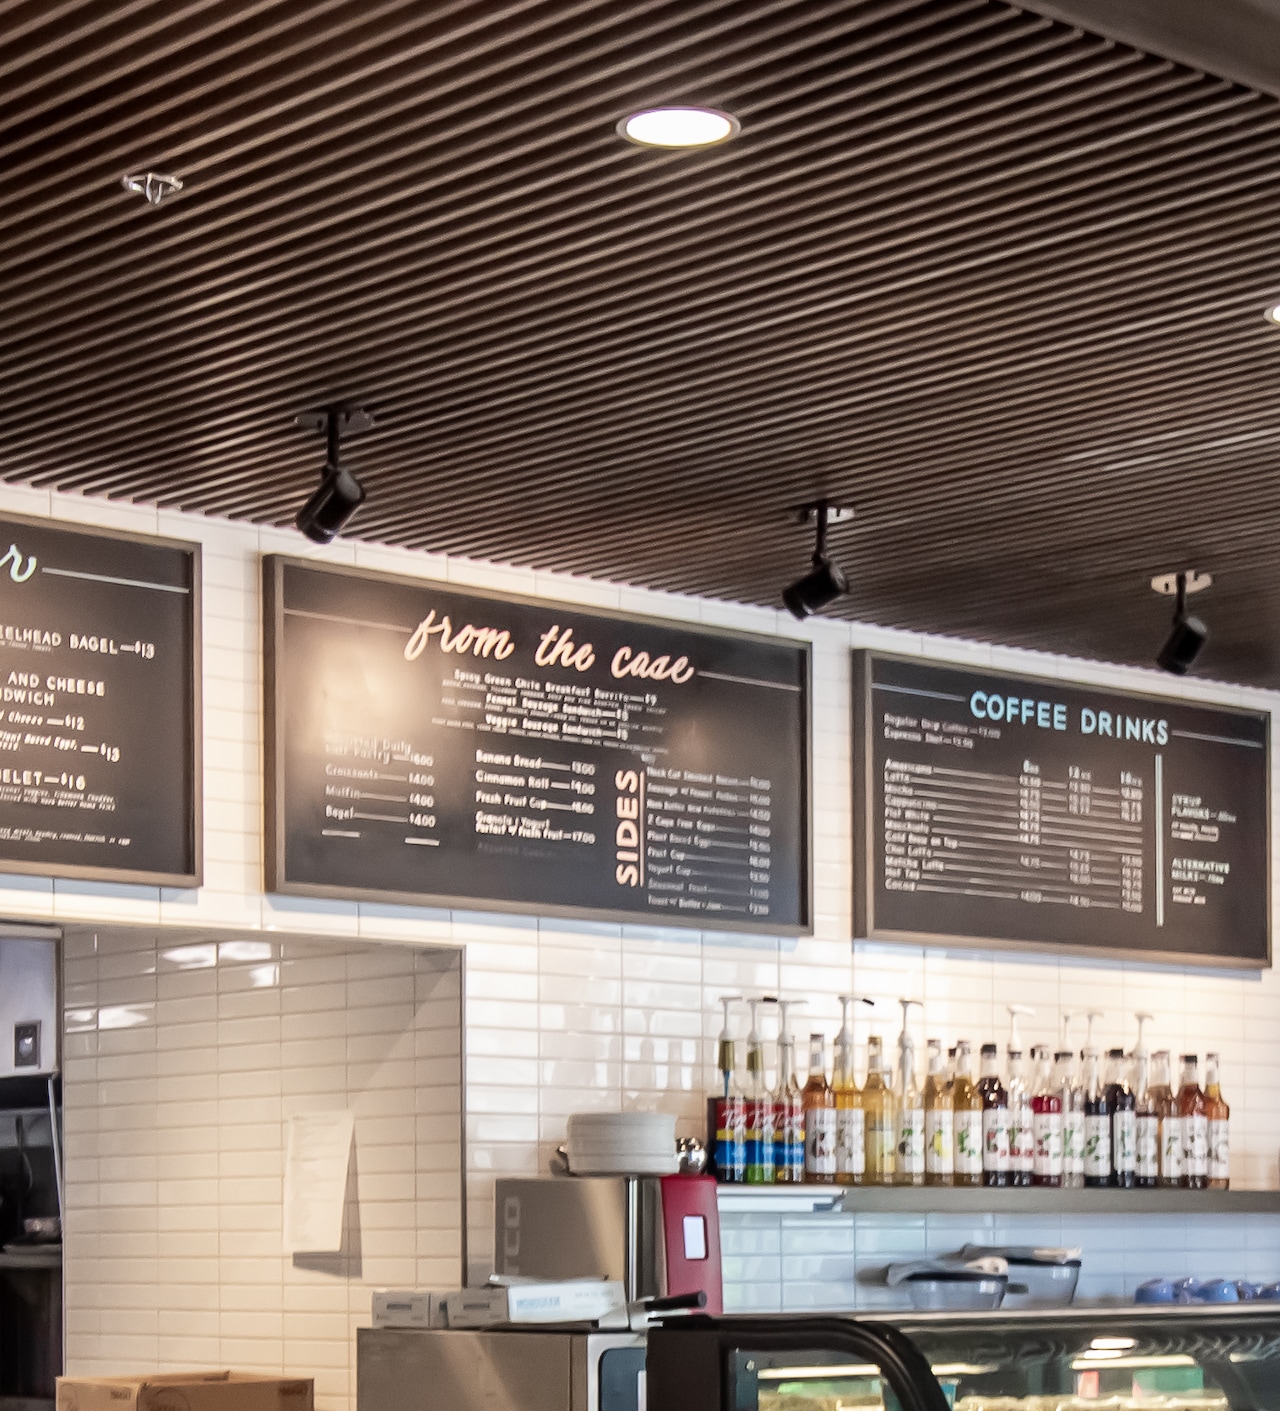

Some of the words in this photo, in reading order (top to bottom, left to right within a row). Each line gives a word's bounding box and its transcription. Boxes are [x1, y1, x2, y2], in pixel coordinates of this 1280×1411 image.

[69, 633, 118, 655] BAGEL
[403, 608, 515, 661] from
[534, 624, 596, 672] the
[610, 645, 695, 684] case
[8, 671, 40, 688] AND
[46, 675, 105, 697] CHEESE
[454, 668, 481, 685] Spicy
[484, 672, 511, 687] Green
[545, 681, 591, 698] Breakfast
[594, 688, 630, 703] Burrito
[521, 697, 559, 714] Sausage
[562, 703, 602, 718] Sandwich
[969, 690, 1067, 731] COFFEE
[1080, 707, 1169, 746] DRINKS
[8, 711, 43, 726] Cheese
[485, 713, 518, 729] Veggie
[521, 717, 559, 733] Sausage
[562, 723, 602, 737] Sandwich
[24, 733, 51, 747] Based
[475, 749, 512, 766] Banana
[514, 754, 542, 769] Bread
[325, 762, 379, 780] Croissants
[475, 769, 526, 787] Cinnamon
[528, 775, 549, 789] Roll
[325, 784, 361, 800] Muffin
[475, 790, 502, 805] Fresh
[504, 793, 528, 808] Fruit
[529, 796, 548, 811] Cup
[325, 804, 354, 821] Bagel
[615, 769, 639, 888] SIDES
[1172, 857, 1230, 875] ALTERNATIVE
